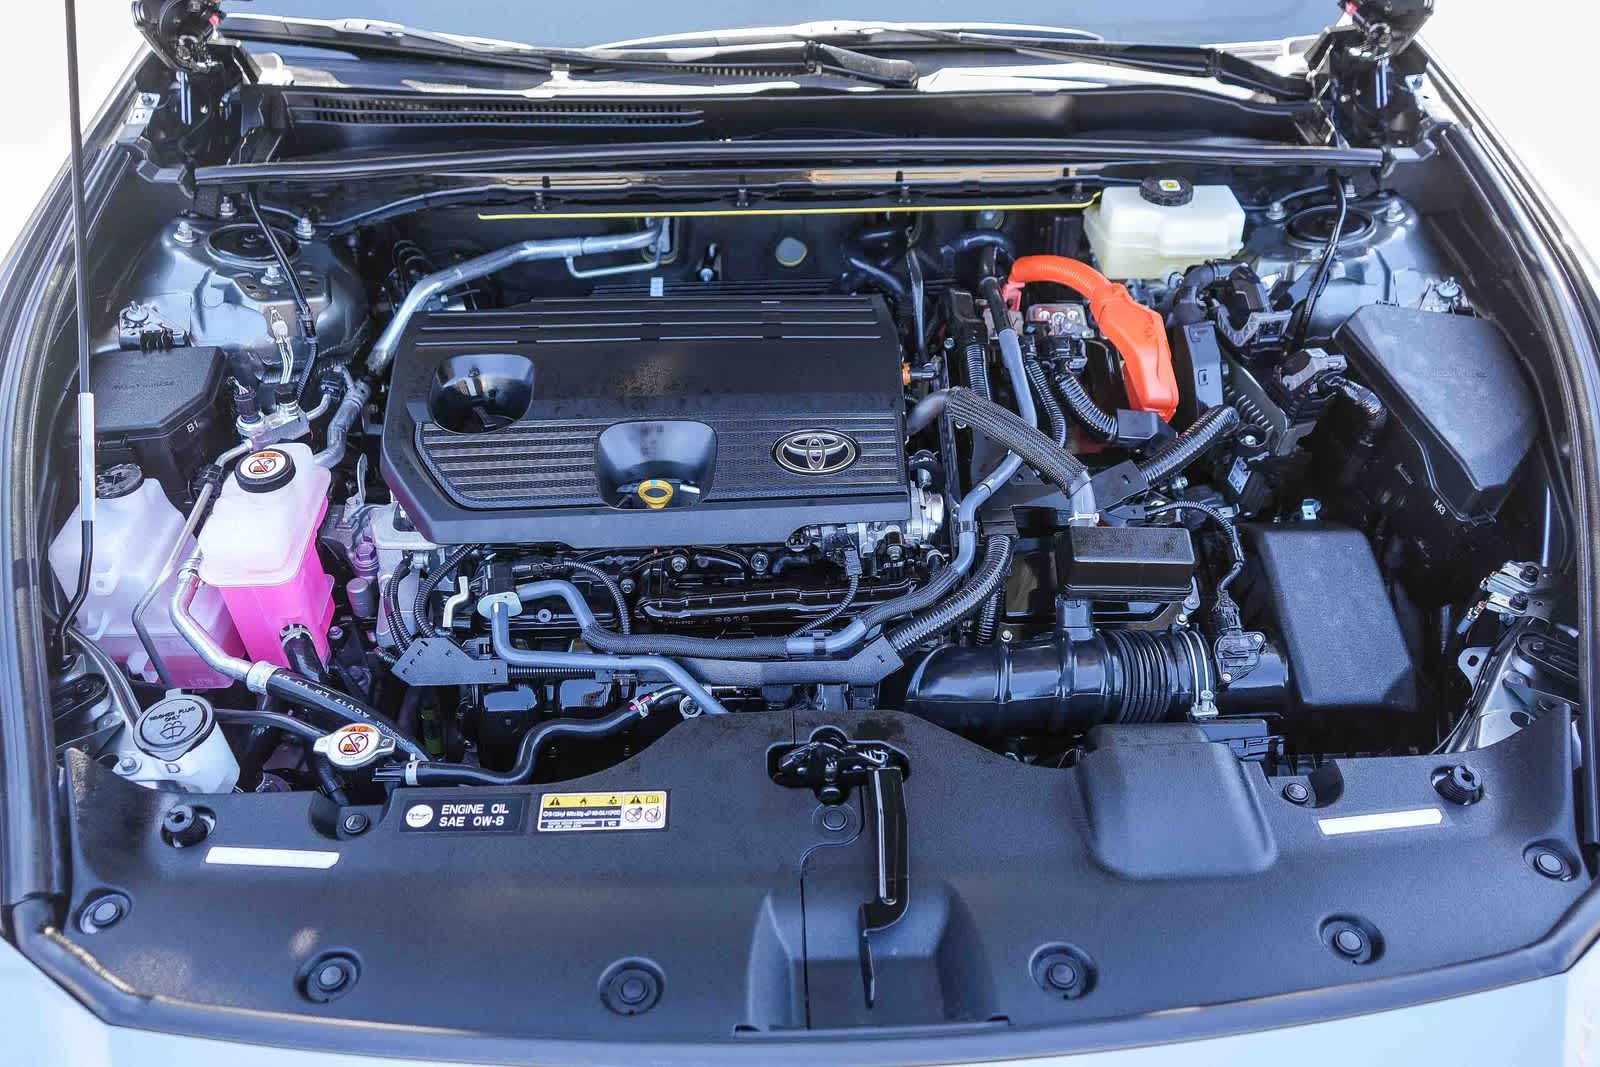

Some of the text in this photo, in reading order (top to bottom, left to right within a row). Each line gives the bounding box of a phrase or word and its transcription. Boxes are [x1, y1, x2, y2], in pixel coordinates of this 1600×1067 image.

[187, 420, 200, 433] B1
[1433, 499, 1446, 515] M3
[441, 803, 510, 815] ENGINE OIL
[439, 816, 465, 828] SAE
